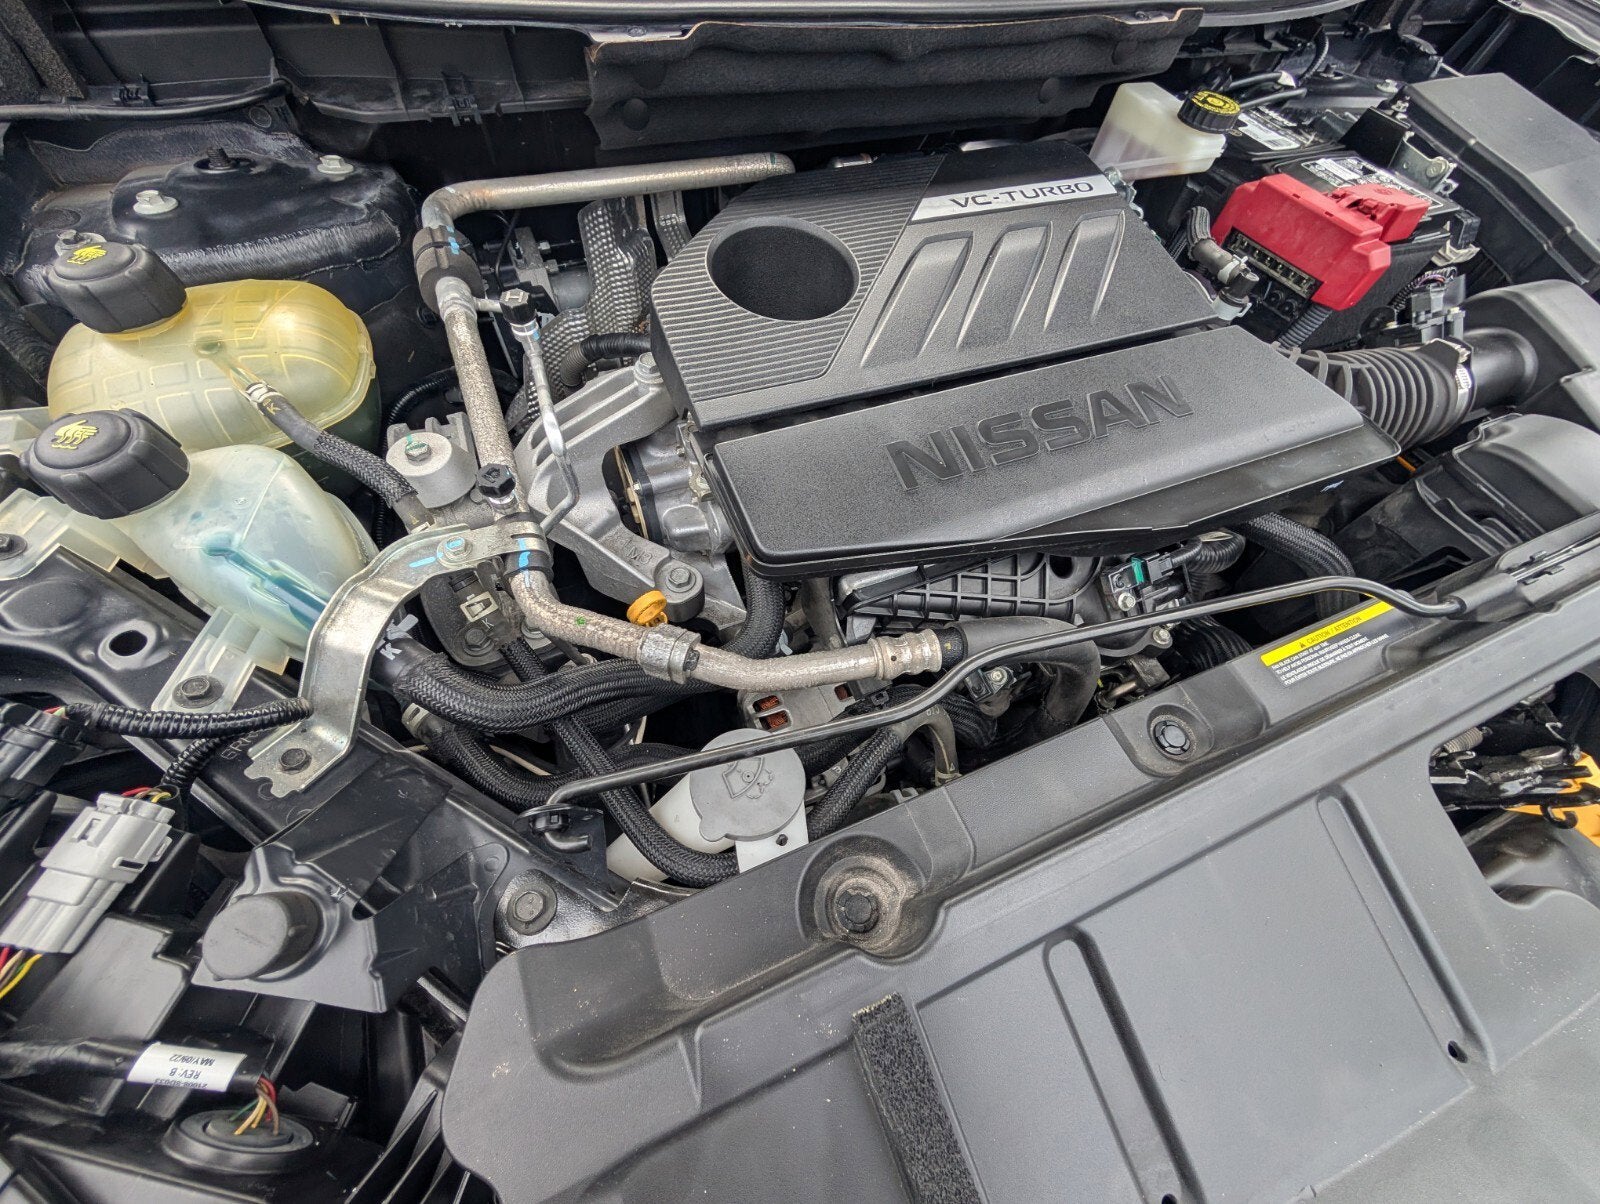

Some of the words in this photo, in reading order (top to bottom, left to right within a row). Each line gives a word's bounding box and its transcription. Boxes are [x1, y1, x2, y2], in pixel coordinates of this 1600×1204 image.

[950, 182, 1094, 208] VC-TURBO
[885, 375, 1195, 491] NISSAN
[1306, 629, 1331, 644] CAUTION
[1334, 616, 1362, 632] ATTENTION
[169, 1054, 215, 1066] MAY/09/22
